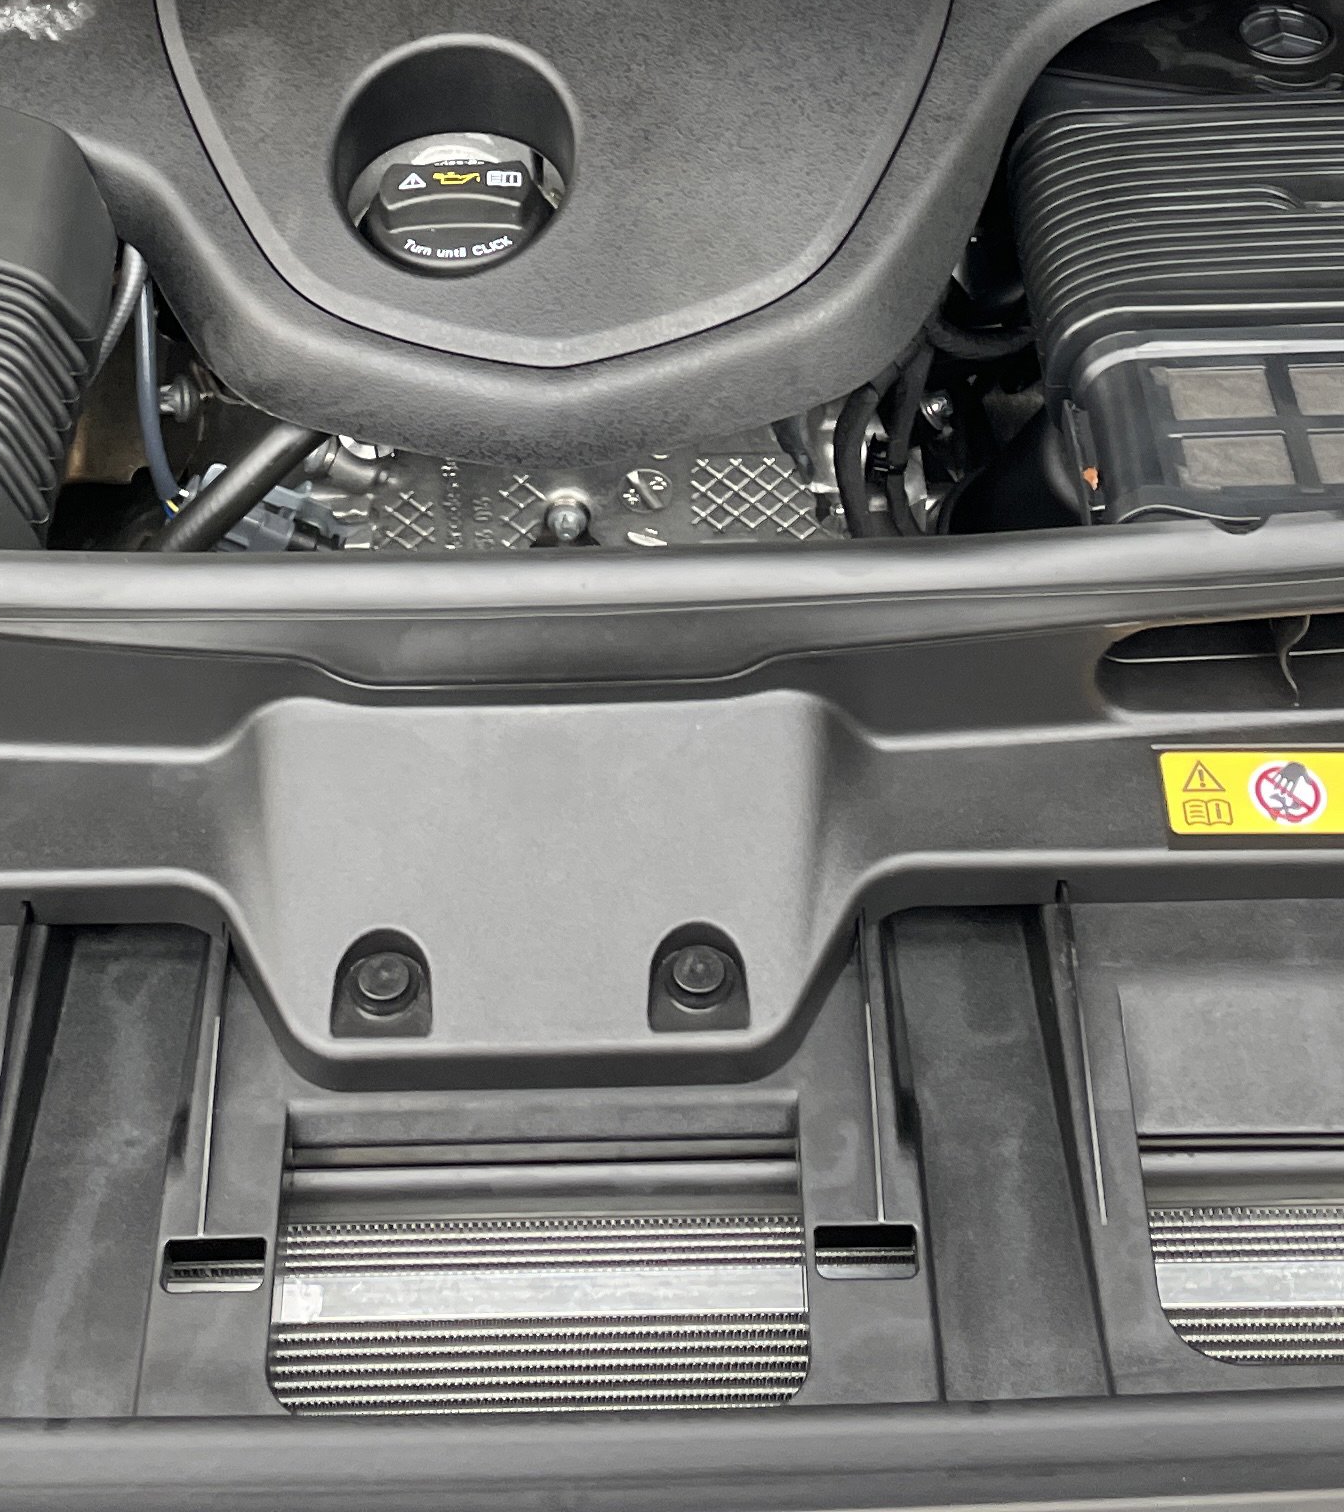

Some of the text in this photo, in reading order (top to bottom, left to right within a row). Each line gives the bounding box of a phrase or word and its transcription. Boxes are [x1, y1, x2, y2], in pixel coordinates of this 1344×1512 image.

[403, 235, 514, 258] Turn until CLICK
